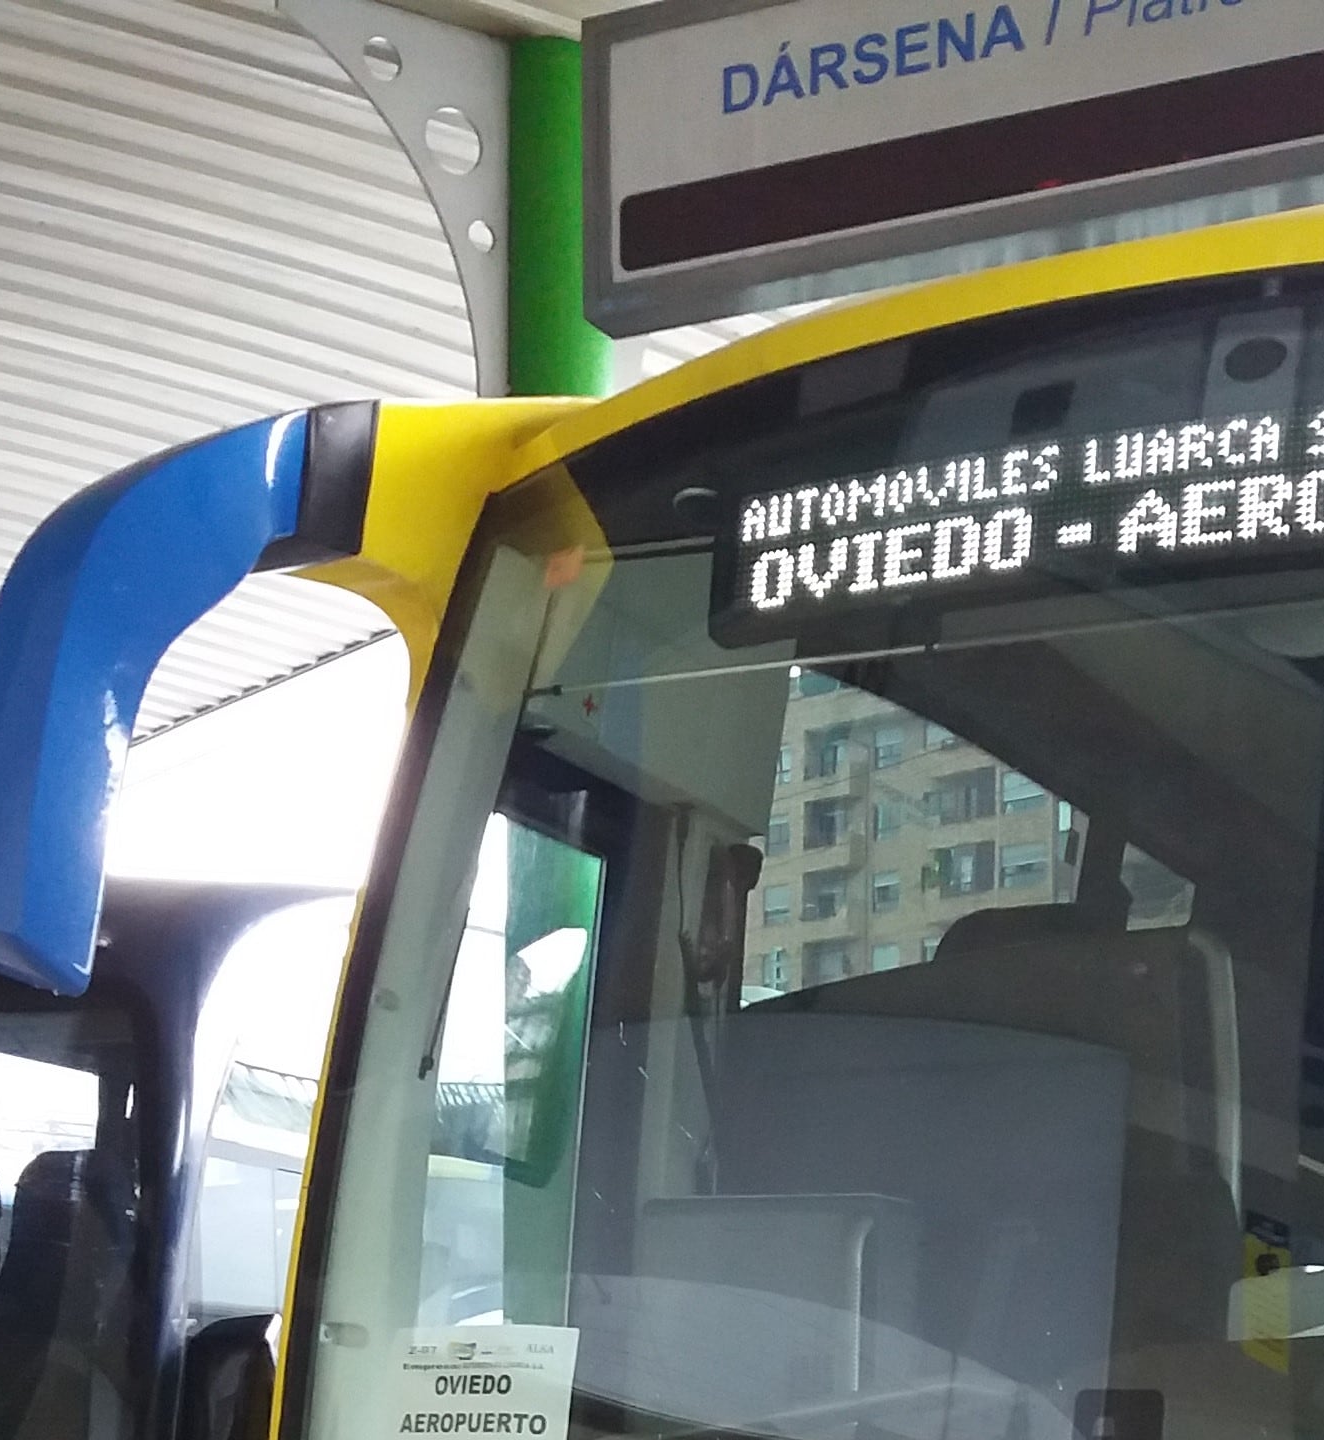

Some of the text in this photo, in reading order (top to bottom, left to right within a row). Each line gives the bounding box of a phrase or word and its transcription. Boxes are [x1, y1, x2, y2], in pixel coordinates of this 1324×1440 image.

[721, 9, 1026, 114] DÁRSENA
[741, 445, 1061, 542] AUTOMOVILES
[1083, 416, 1279, 484] LUARCA
[751, 507, 1032, 609] OVIEDO
[399, 1412, 547, 1435] AEROPUERTO
[435, 1374, 512, 1395] OVIEDO
